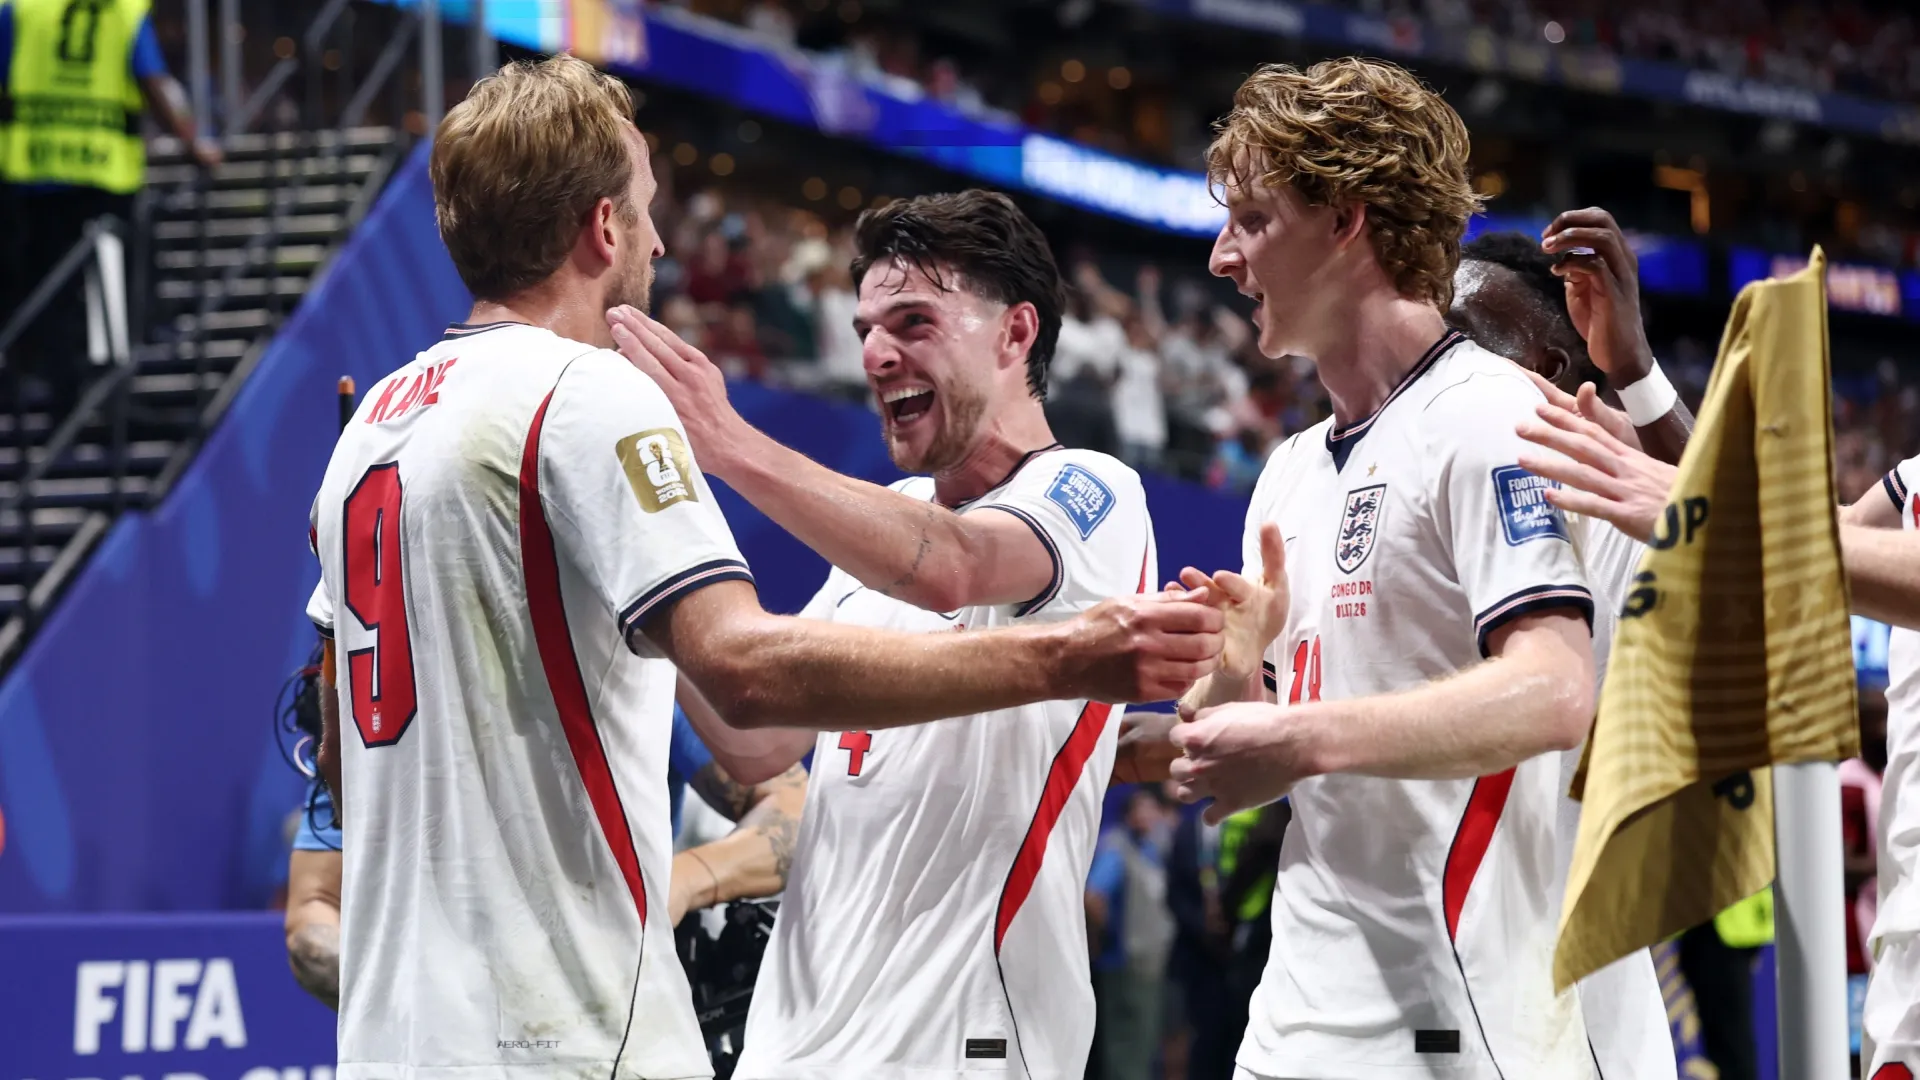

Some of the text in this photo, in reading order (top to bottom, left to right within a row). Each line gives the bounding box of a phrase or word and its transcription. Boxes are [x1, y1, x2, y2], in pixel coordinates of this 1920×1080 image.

[364, 357, 459, 424] KANE
[1060, 483, 1098, 522] the World
[1068, 474, 1103, 511] UNITES
[1510, 487, 1546, 508] UNIT
[1529, 518, 1552, 528] FIFA
[1650, 496, 1709, 549] UP
[343, 460, 417, 749] 9
[1331, 580, 1373, 598] CONGO DR
[1620, 570, 1657, 620] 6
[73, 957, 248, 1056] FIFA
[497, 1040, 561, 1049] AERO-FIT
